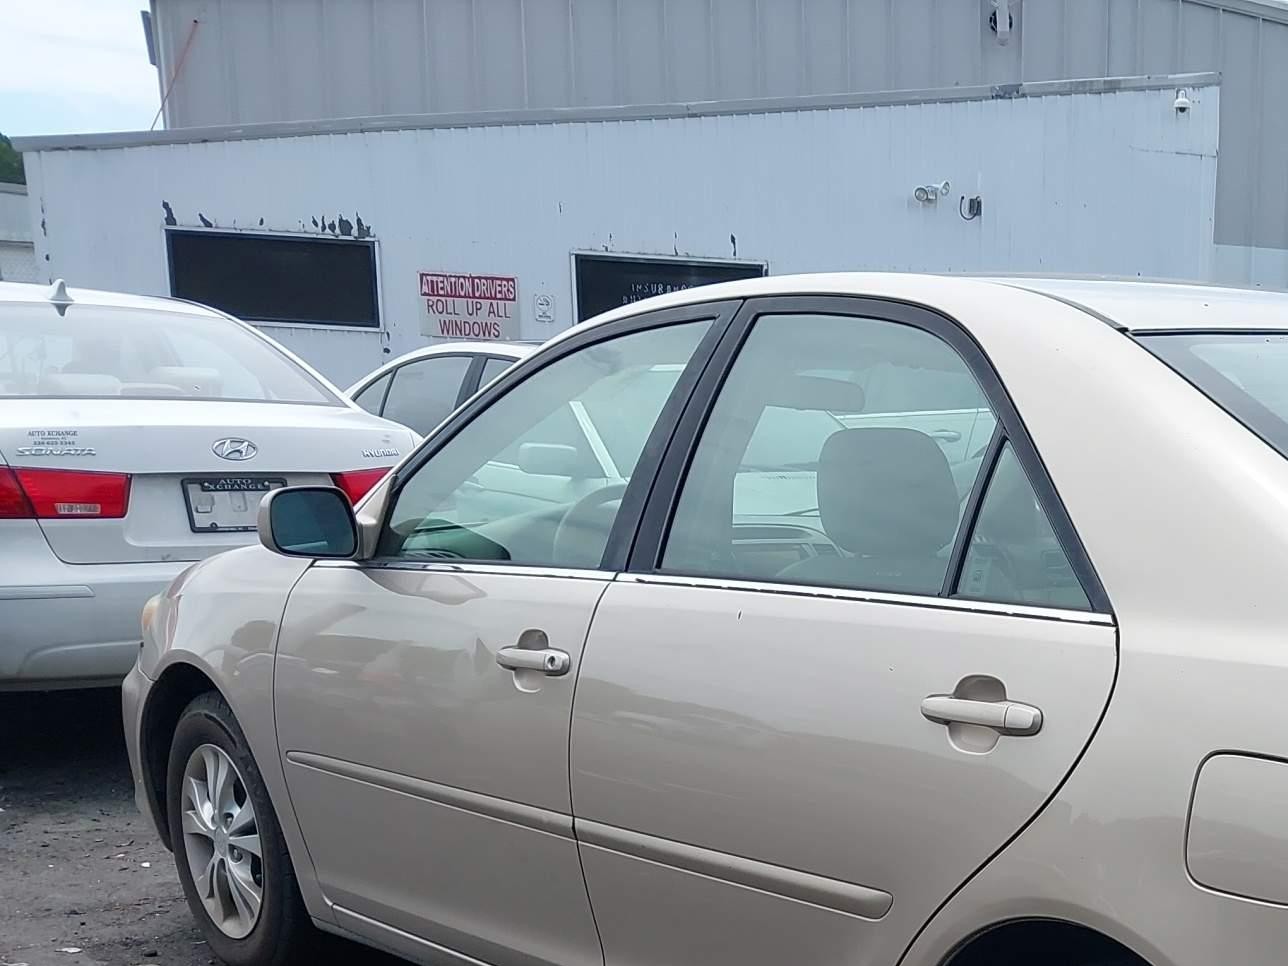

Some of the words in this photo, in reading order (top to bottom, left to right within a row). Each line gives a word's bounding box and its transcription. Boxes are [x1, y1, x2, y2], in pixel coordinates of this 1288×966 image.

[421, 276, 472, 297] ATTENTION
[475, 278, 515, 299] DRIVERS
[426, 299, 460, 316] ROLL
[466, 300, 483, 316] UP
[487, 302, 511, 318] ALL
[439, 319, 501, 338] WINDOWS
[16, 447, 96, 456] SONATA
[361, 448, 399, 457] HYUNDAI
